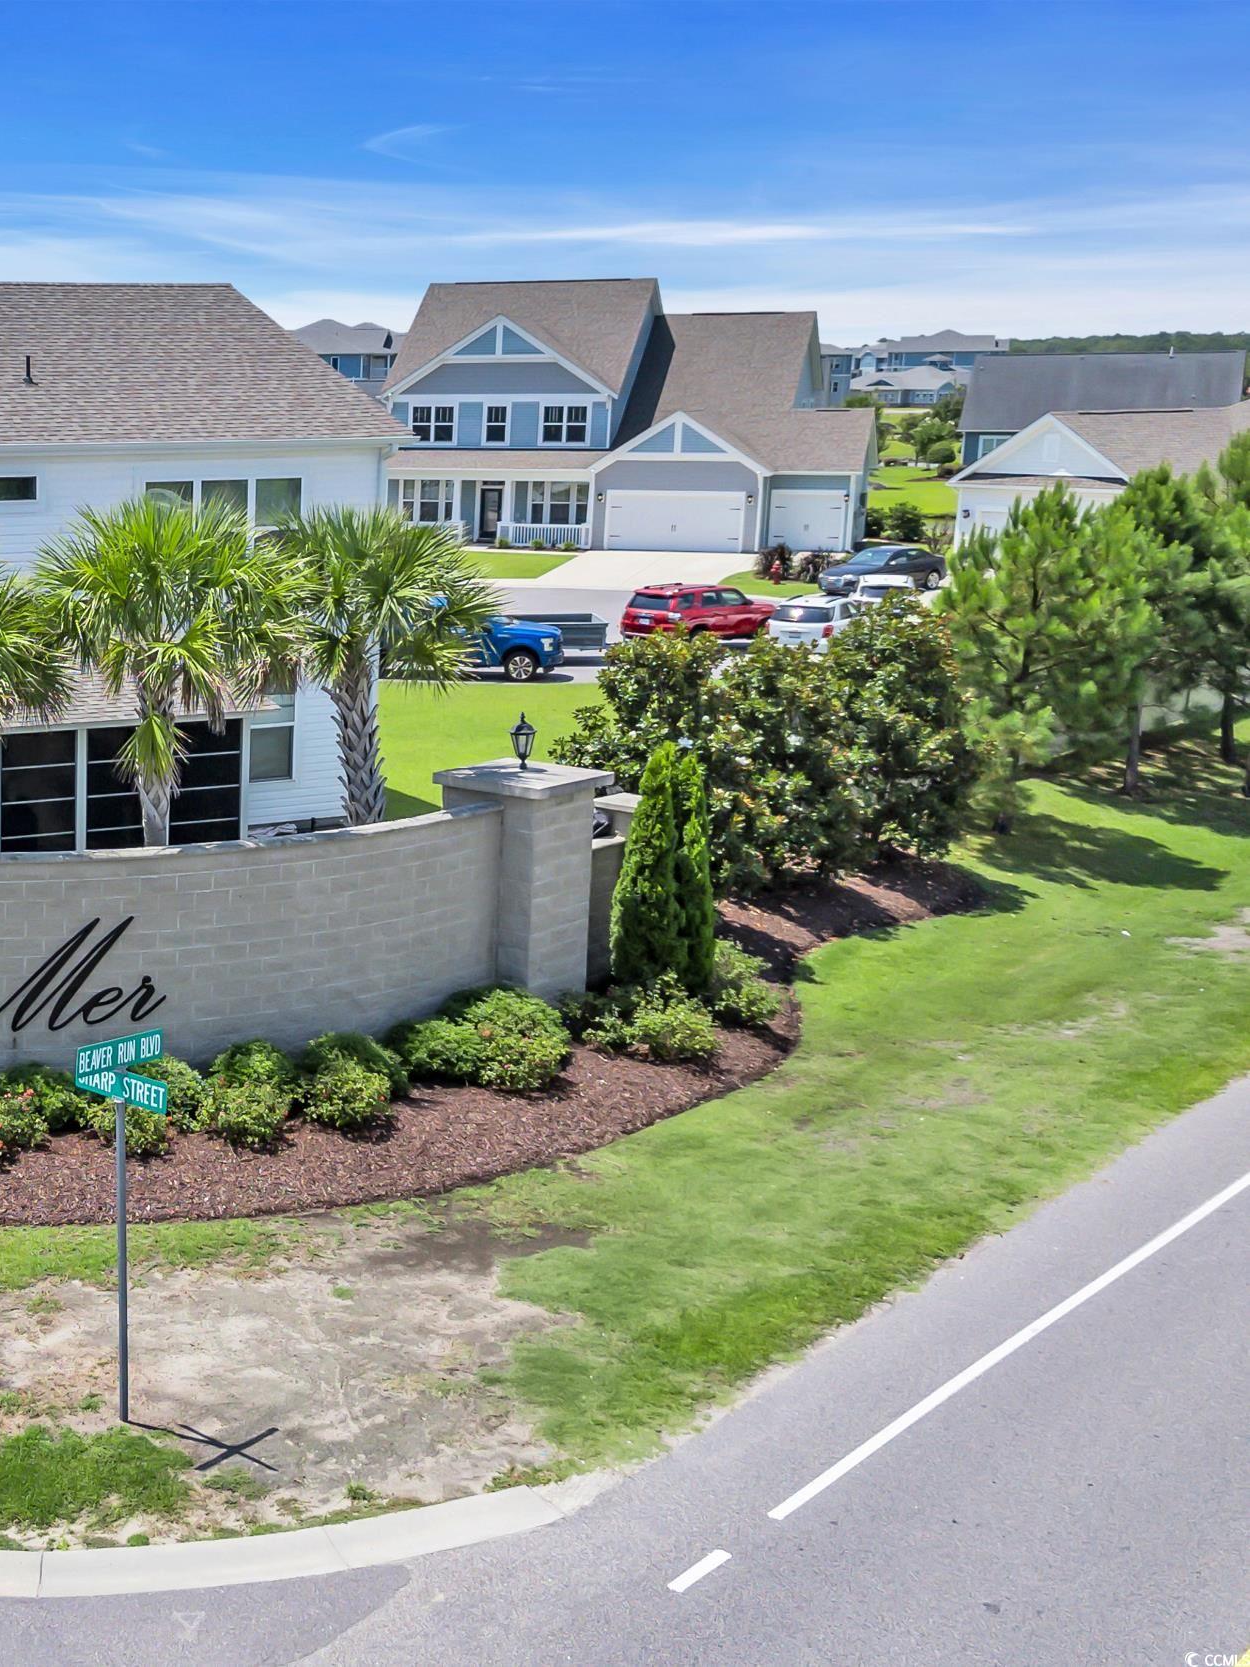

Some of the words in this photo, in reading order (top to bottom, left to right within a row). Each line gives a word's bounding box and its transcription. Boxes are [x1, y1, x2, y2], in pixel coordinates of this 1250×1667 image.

[78, 1045, 113, 1074] BEAVER
[117, 1039, 136, 1065] RUN
[140, 1033, 161, 1059] BLVD
[122, 1076, 165, 1109] STREET
